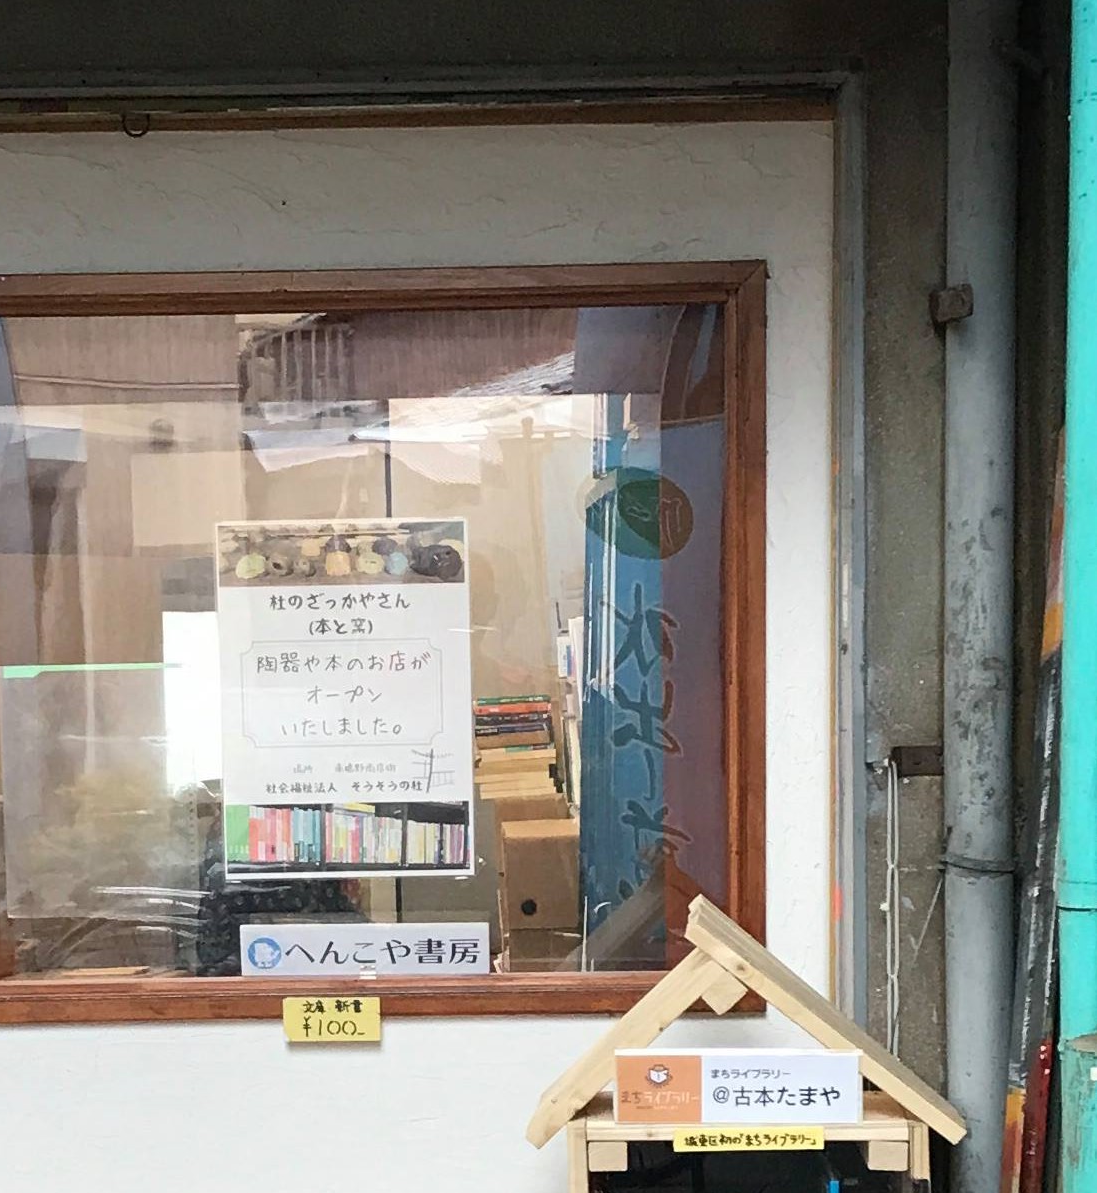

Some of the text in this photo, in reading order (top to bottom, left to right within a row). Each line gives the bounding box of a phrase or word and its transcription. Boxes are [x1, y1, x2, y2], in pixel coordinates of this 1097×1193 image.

[269, 592, 411, 611] 杜のざっかやさん
[256, 651, 432, 674] 陶器や本のお店が
[306, 685, 383, 704] オープン
[281, 717, 403, 737] いたしました。
[285, 937, 481, 965] へんこや書房
[711, 1069, 791, 1079] まちライブラリー
[712, 1086, 841, 1107] @古本たまや
